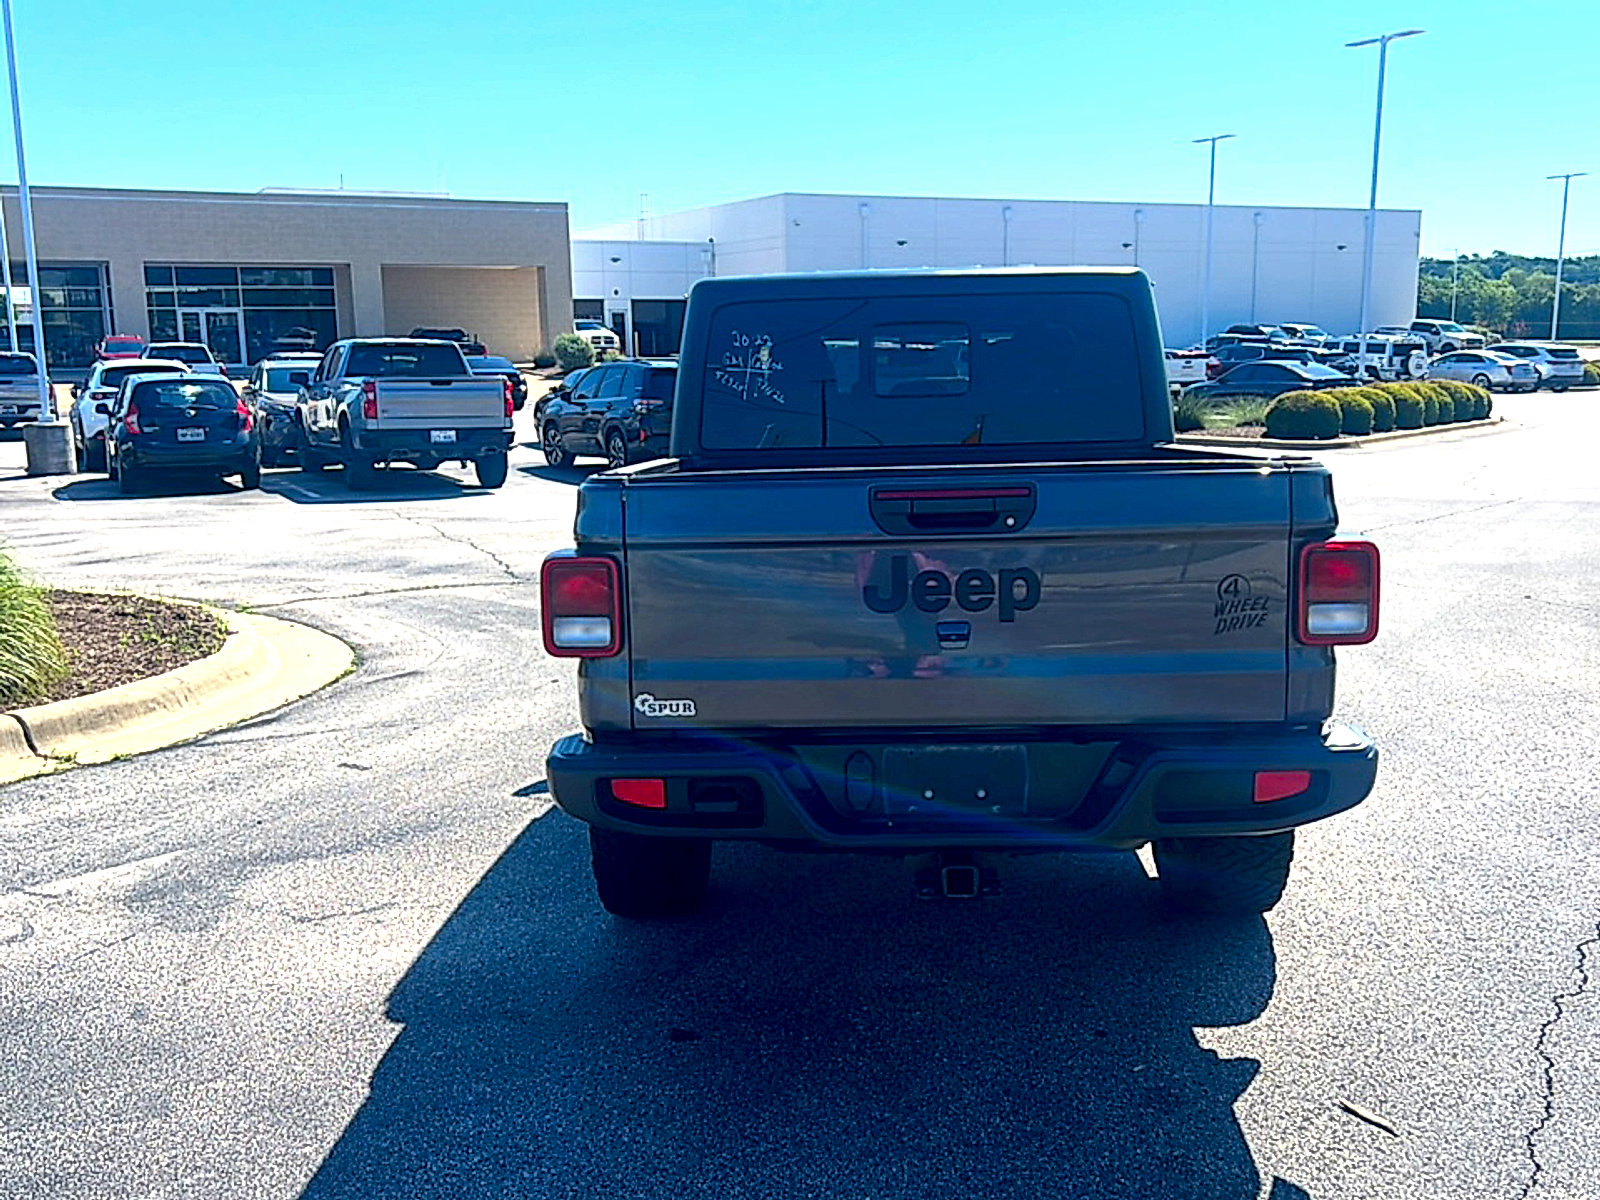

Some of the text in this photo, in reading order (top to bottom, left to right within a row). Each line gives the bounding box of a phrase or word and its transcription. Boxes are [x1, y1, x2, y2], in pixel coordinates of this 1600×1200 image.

[863, 555, 1041, 622] Jeep
[1214, 596, 1269, 618] WHEEL
[1214, 613, 1268, 635] DRIVE
[647, 703, 693, 714] SPUR
